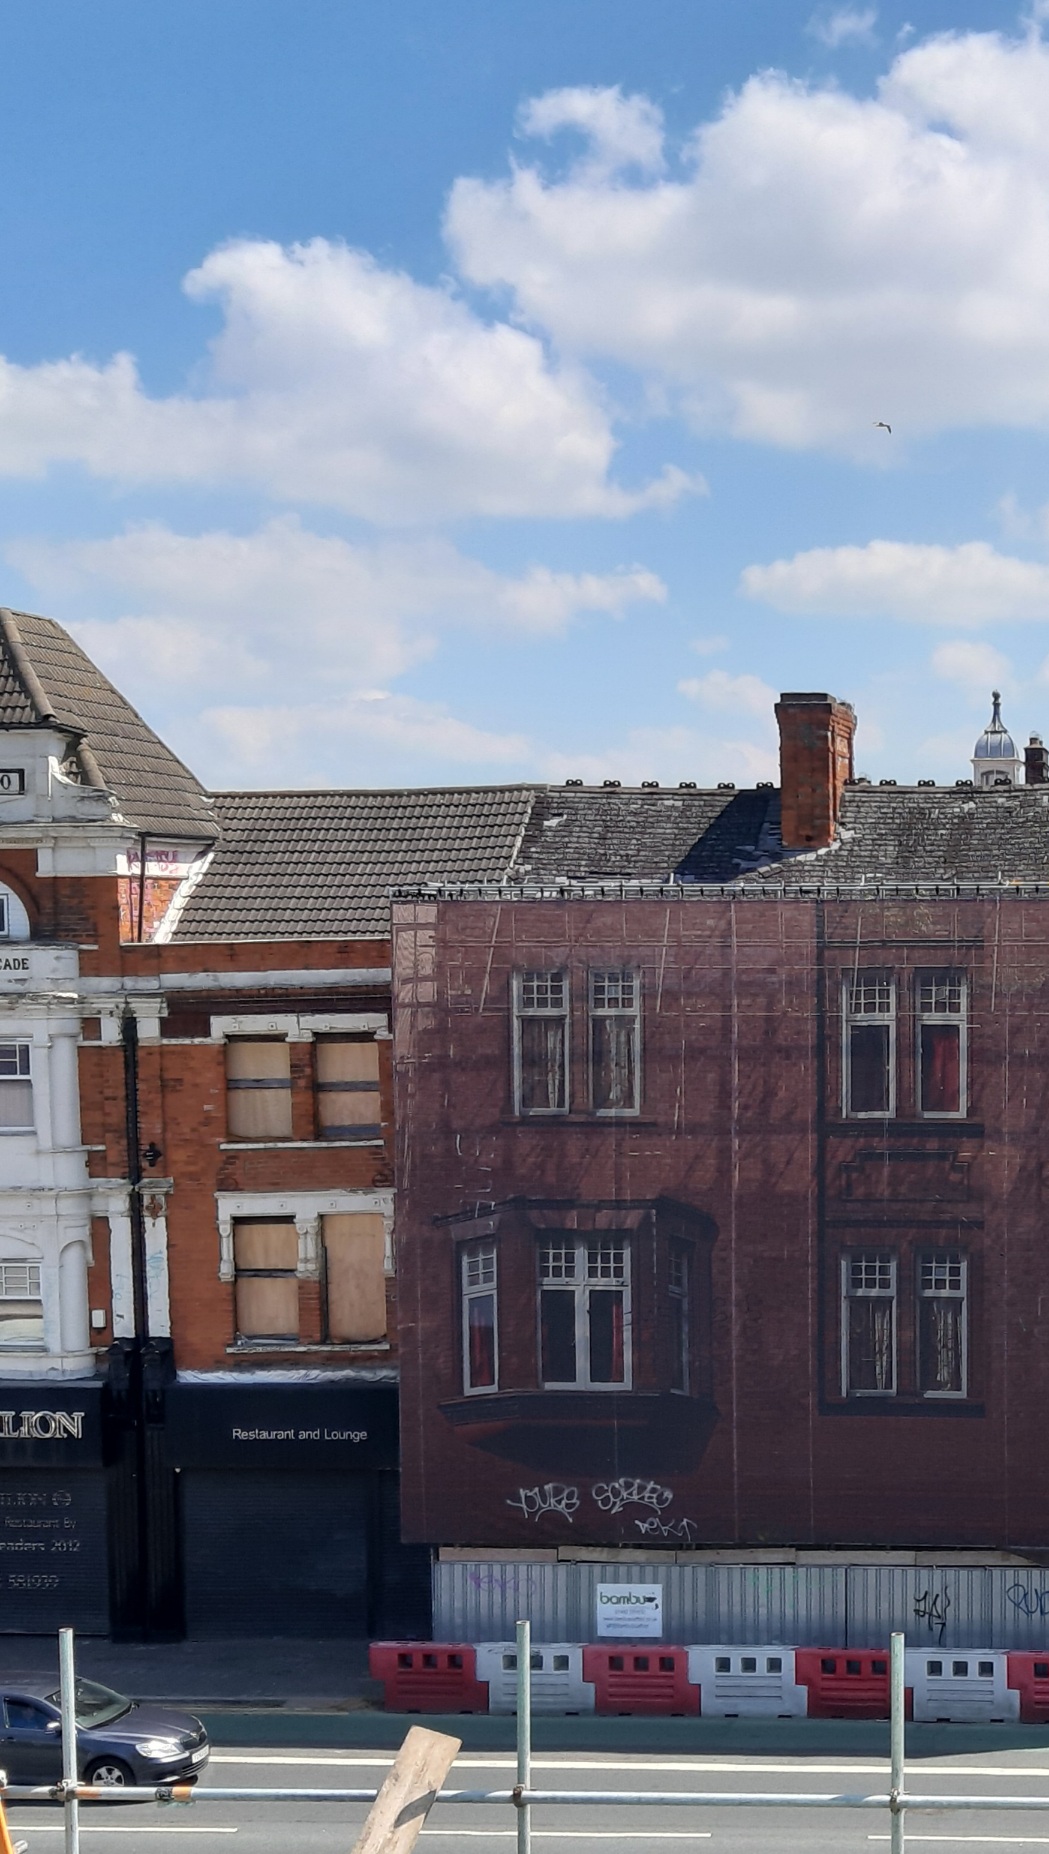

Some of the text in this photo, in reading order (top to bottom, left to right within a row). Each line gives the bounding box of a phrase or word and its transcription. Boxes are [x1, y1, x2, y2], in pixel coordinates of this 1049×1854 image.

[232, 1428, 368, 1443] Restaurant and Lounge
[600, 1591, 646, 1605] bambu
